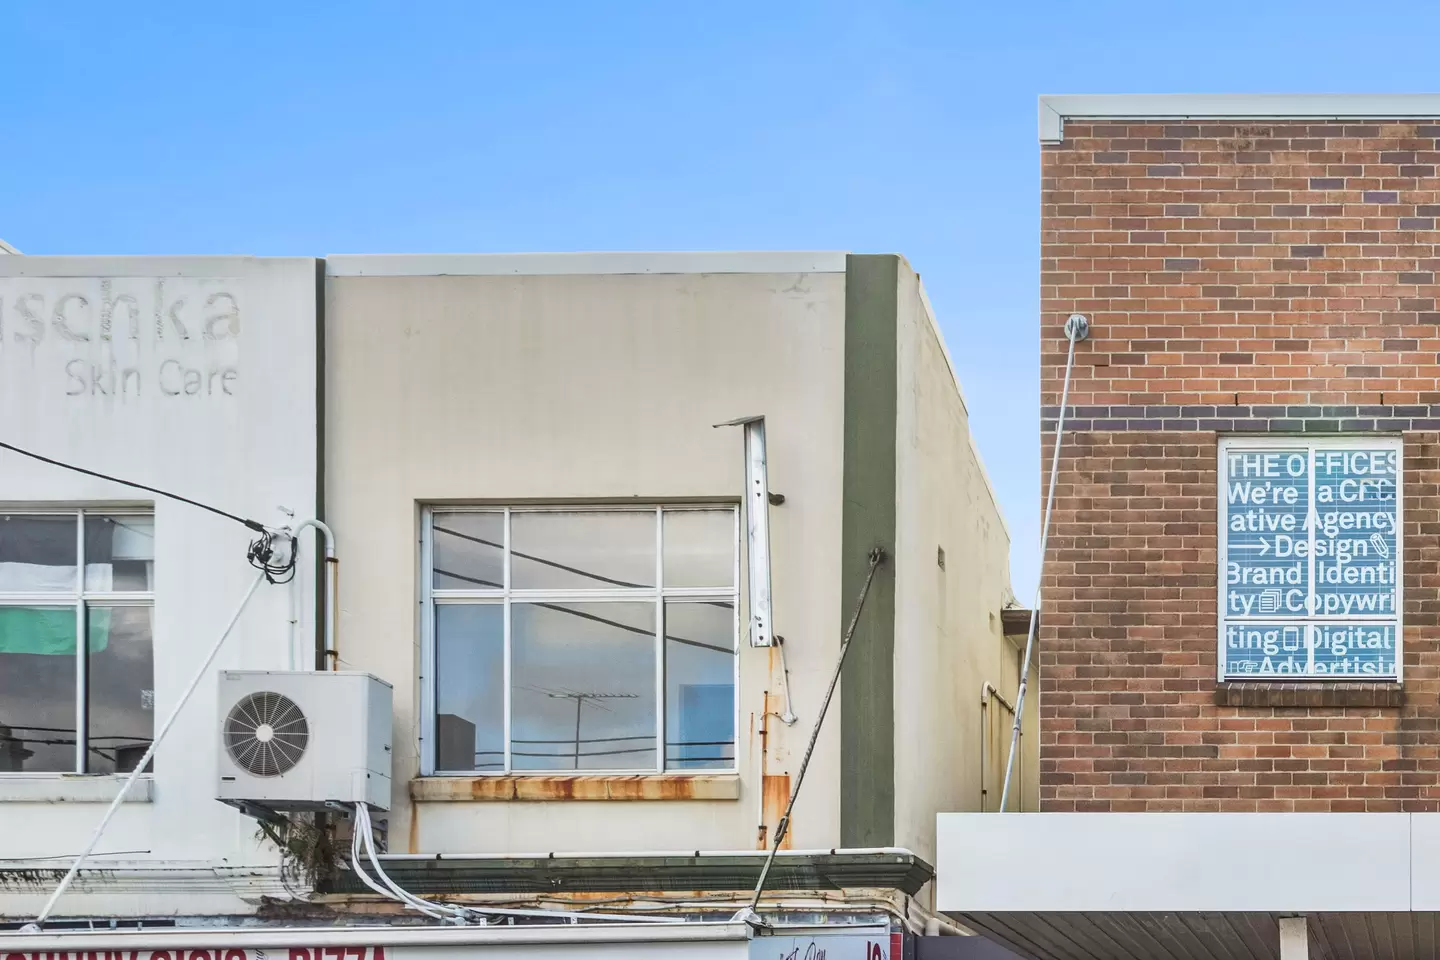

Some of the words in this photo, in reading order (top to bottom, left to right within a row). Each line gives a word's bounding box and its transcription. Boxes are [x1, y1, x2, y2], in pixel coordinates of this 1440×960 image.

[0, 277, 241, 341] schka
[65, 359, 141, 396] Skin
[159, 359, 238, 396] Care
[1228, 454, 1280, 477] THE
[1228, 481, 1298, 504] We're
[1318, 486, 1333, 502] a
[1231, 508, 1296, 531] ative
[1302, 508, 1396, 536] Agency
[1275, 535, 1368, 563] Design
[1228, 562, 1301, 585] Brand
[1319, 561, 1395, 584] Identi
[1229, 590, 1254, 615] ty
[1286, 588, 1395, 615] Copywri
[1227, 627, 1278, 655] ting
[1303, 626, 1389, 655] Digital
